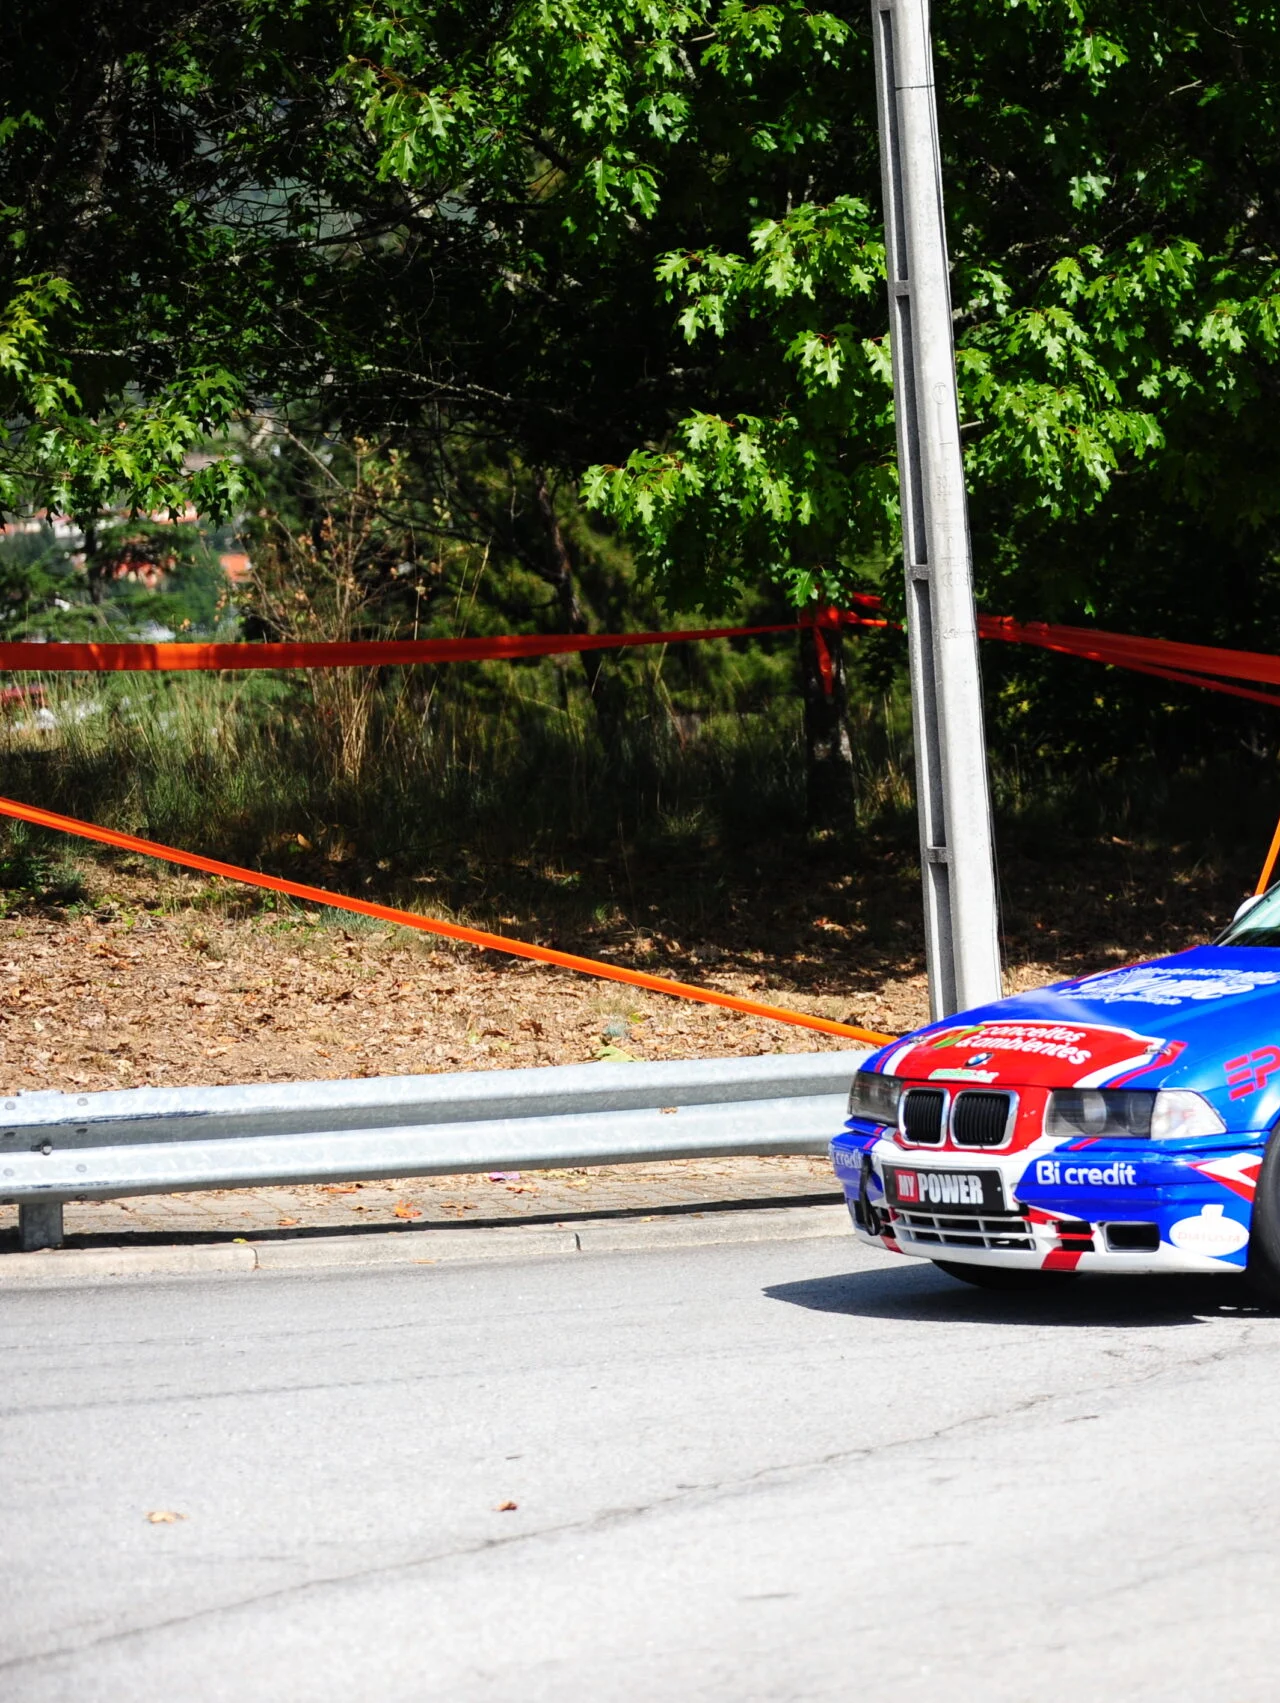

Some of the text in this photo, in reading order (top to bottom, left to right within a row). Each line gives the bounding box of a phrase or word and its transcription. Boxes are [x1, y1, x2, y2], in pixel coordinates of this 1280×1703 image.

[979, 1025, 1087, 1042] conceitos
[1036, 1161, 1137, 1186] Bi credit
[898, 1173, 984, 1204] MY POWER
